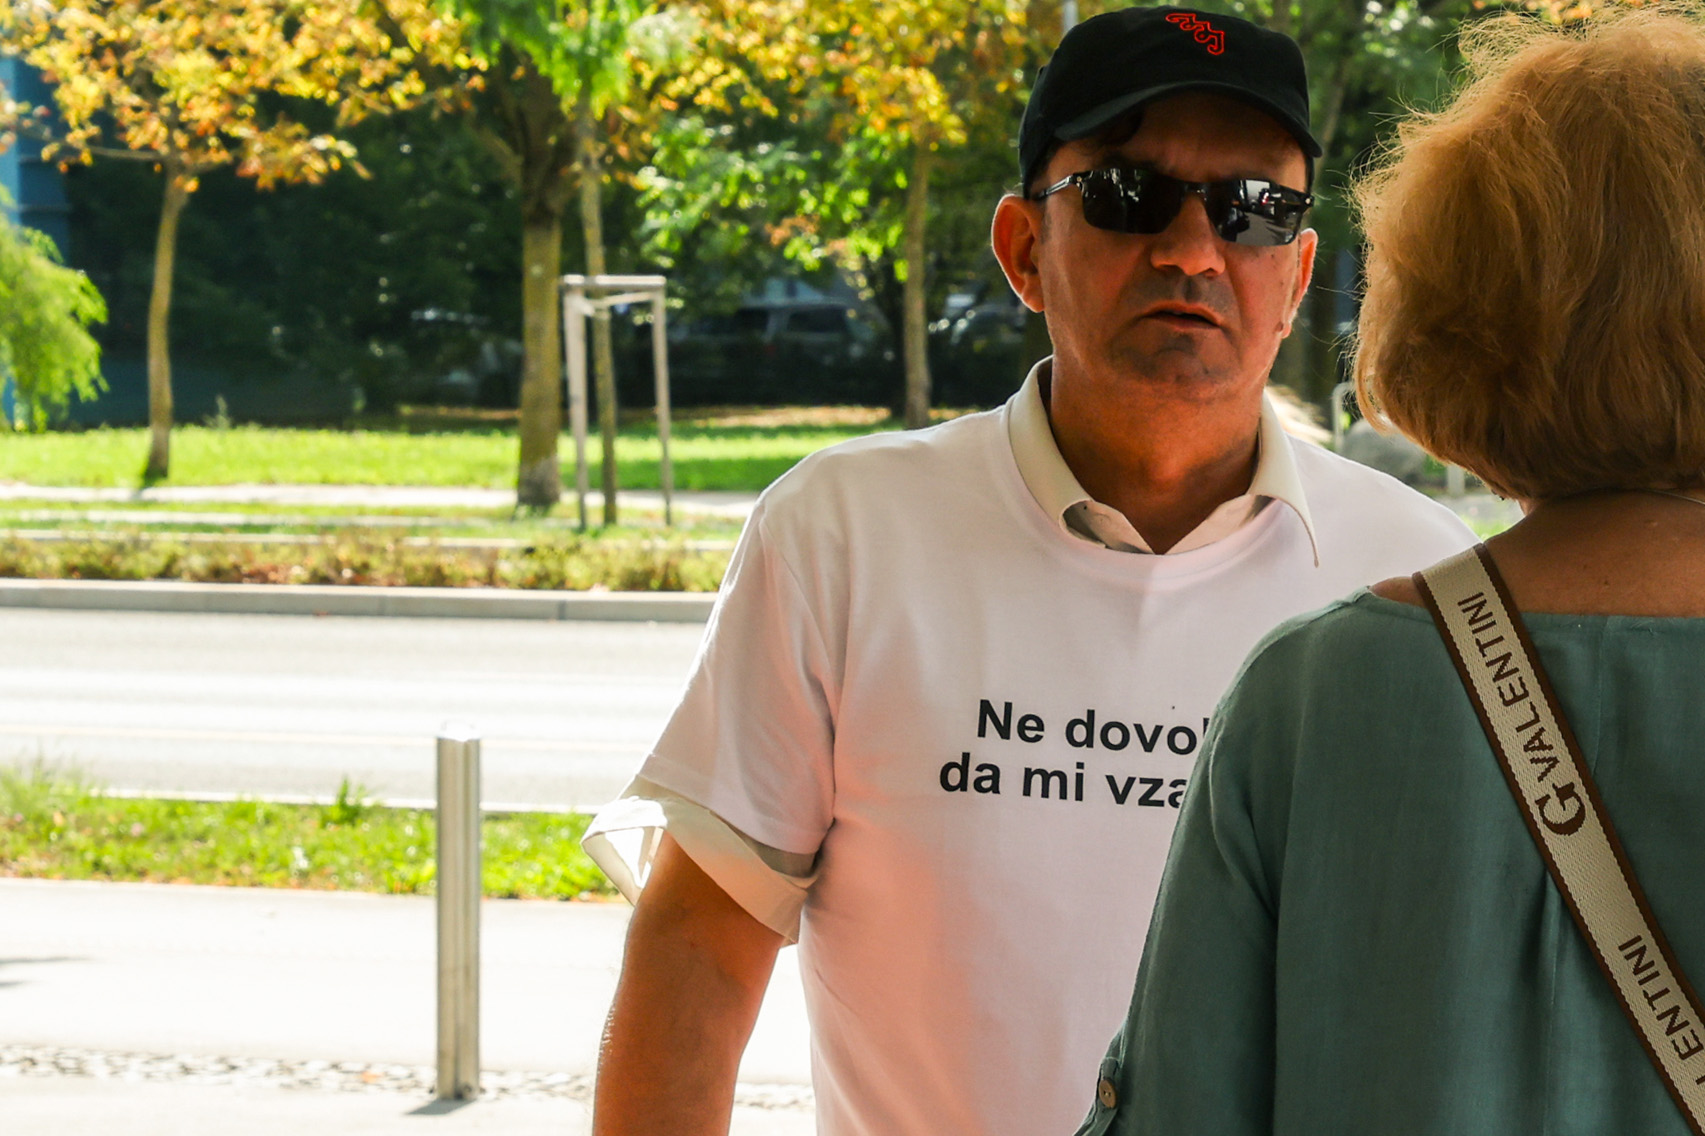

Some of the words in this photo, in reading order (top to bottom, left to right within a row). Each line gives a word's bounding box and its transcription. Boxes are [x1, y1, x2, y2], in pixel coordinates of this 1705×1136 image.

[977, 699, 1045, 743] Ne
[1065, 709, 1210, 755] dovo
[939, 752, 1001, 794] da
[1022, 762, 1085, 802] mi
